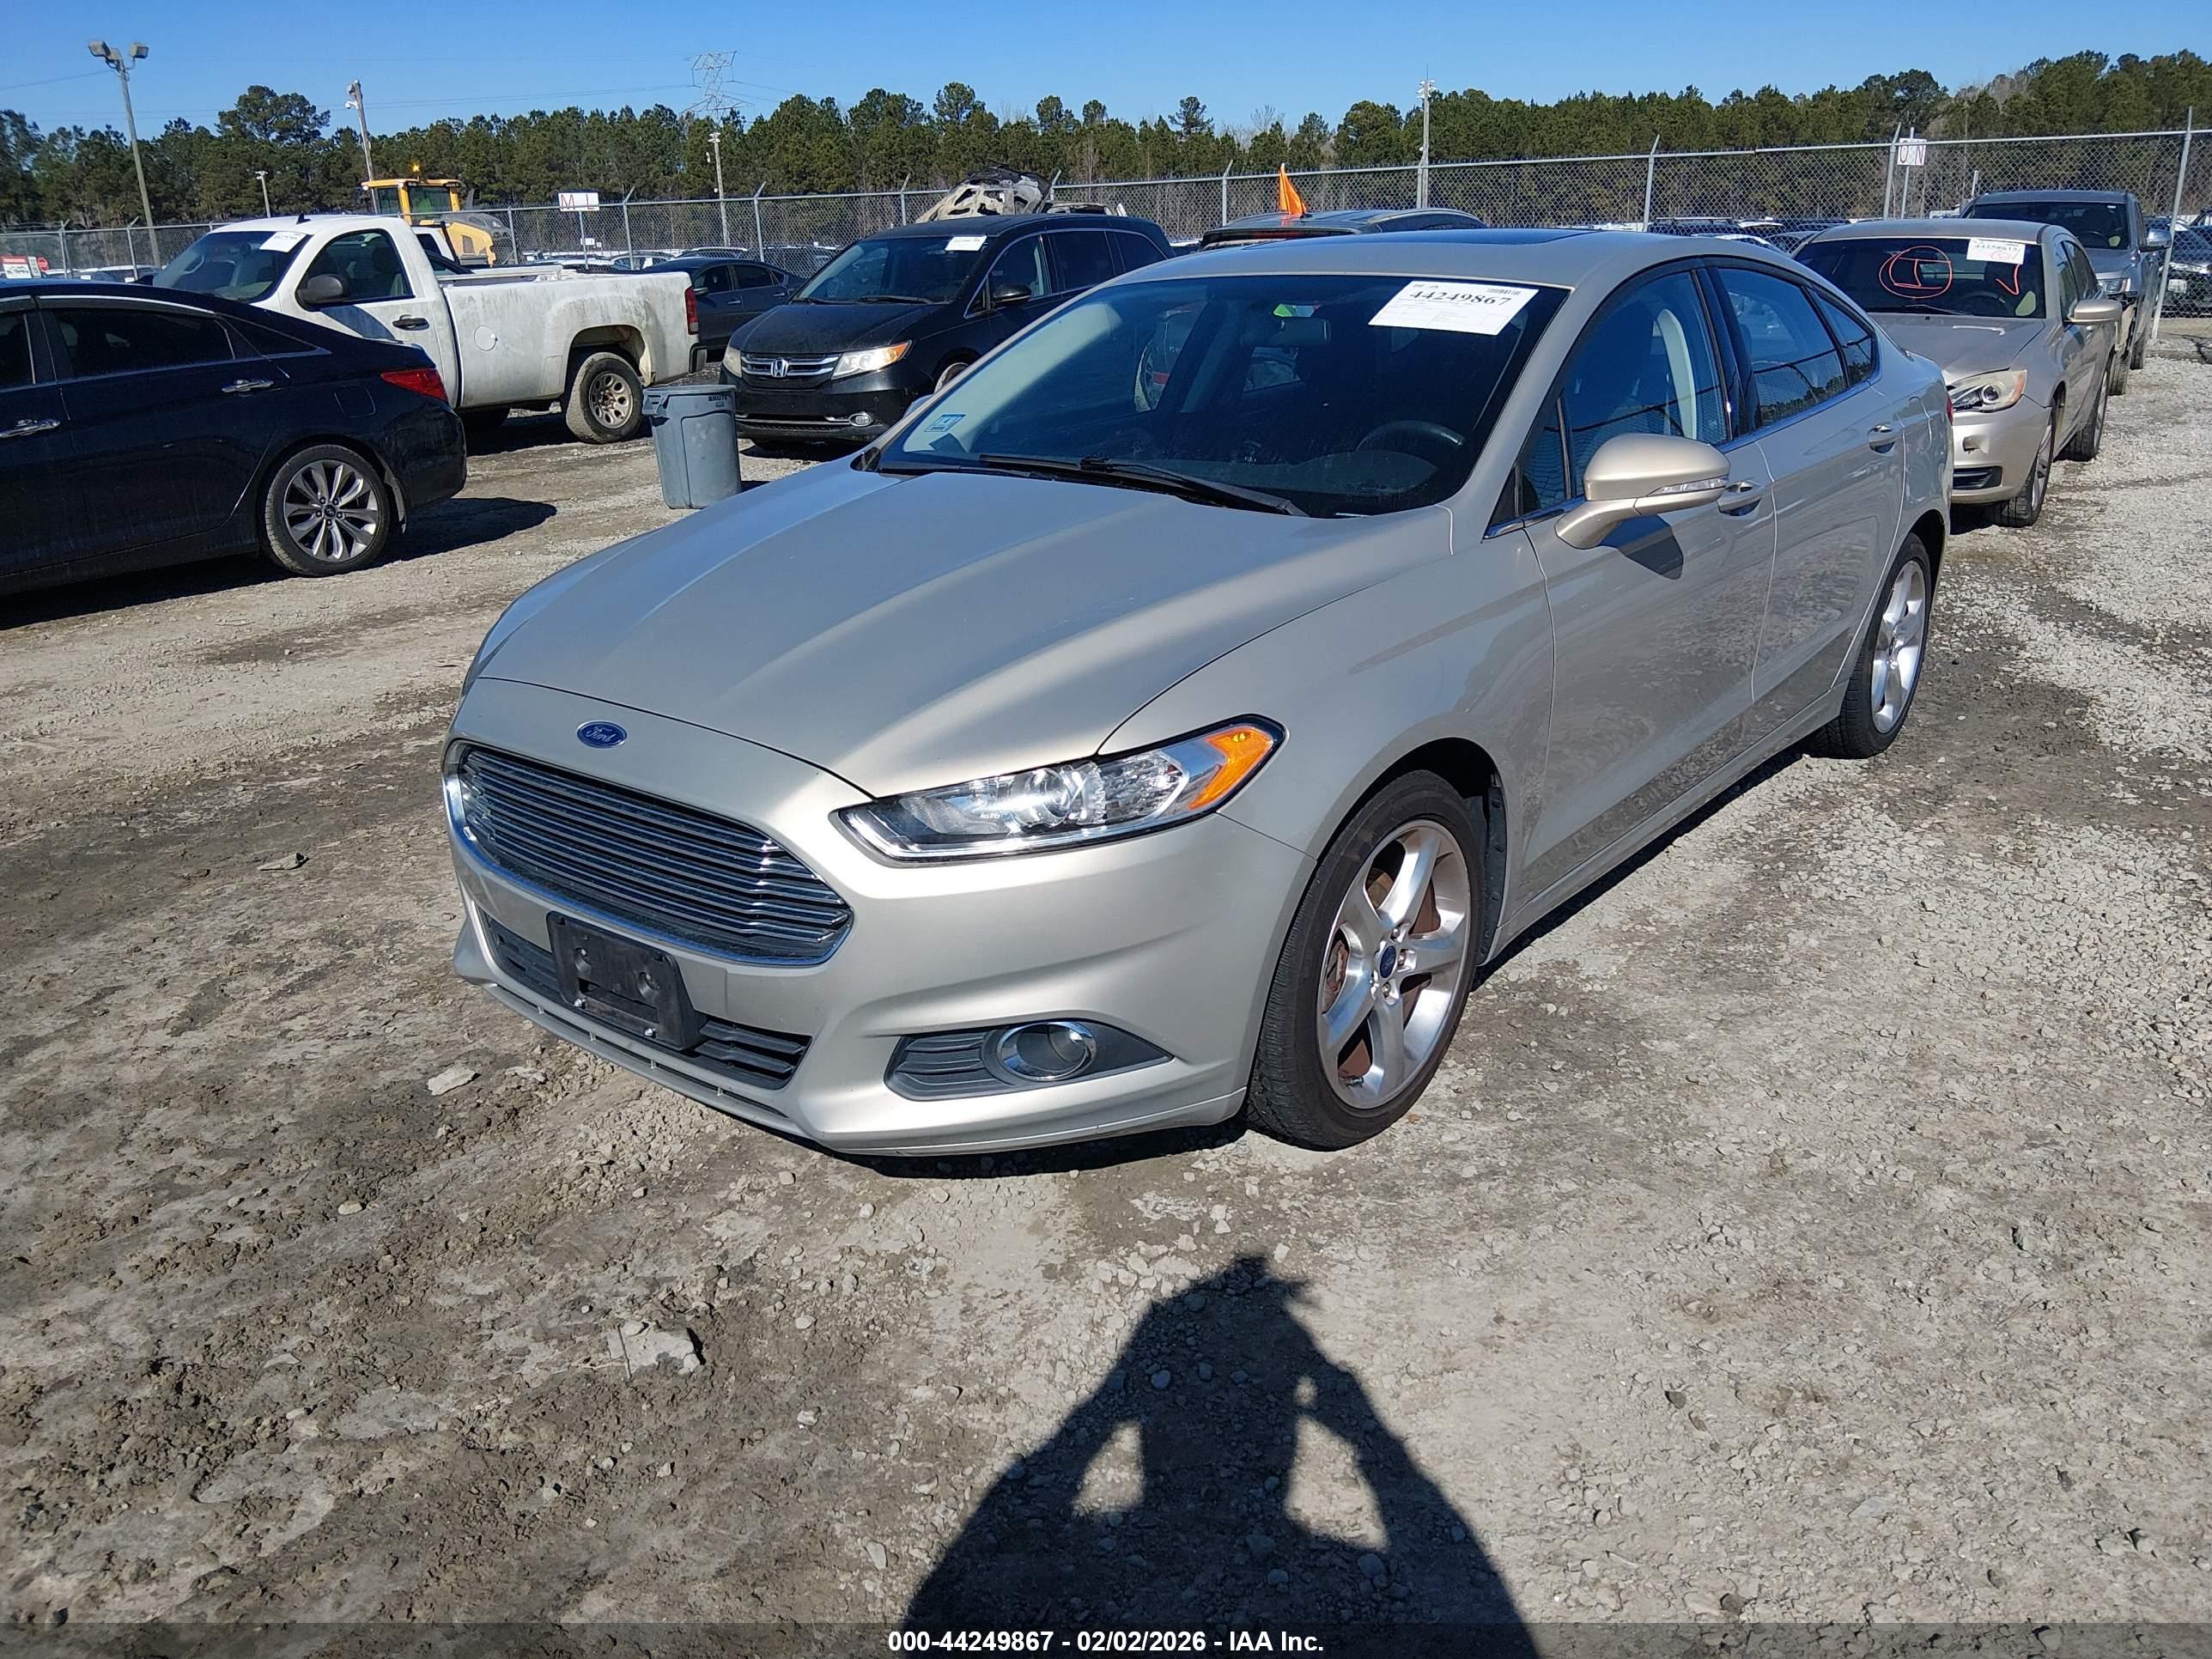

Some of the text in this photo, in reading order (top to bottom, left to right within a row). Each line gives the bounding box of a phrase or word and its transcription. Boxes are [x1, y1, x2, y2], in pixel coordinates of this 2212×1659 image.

[561, 194, 576, 210] M
[1409, 289, 1512, 307] 44249867
[585, 726, 617, 743] Ford
